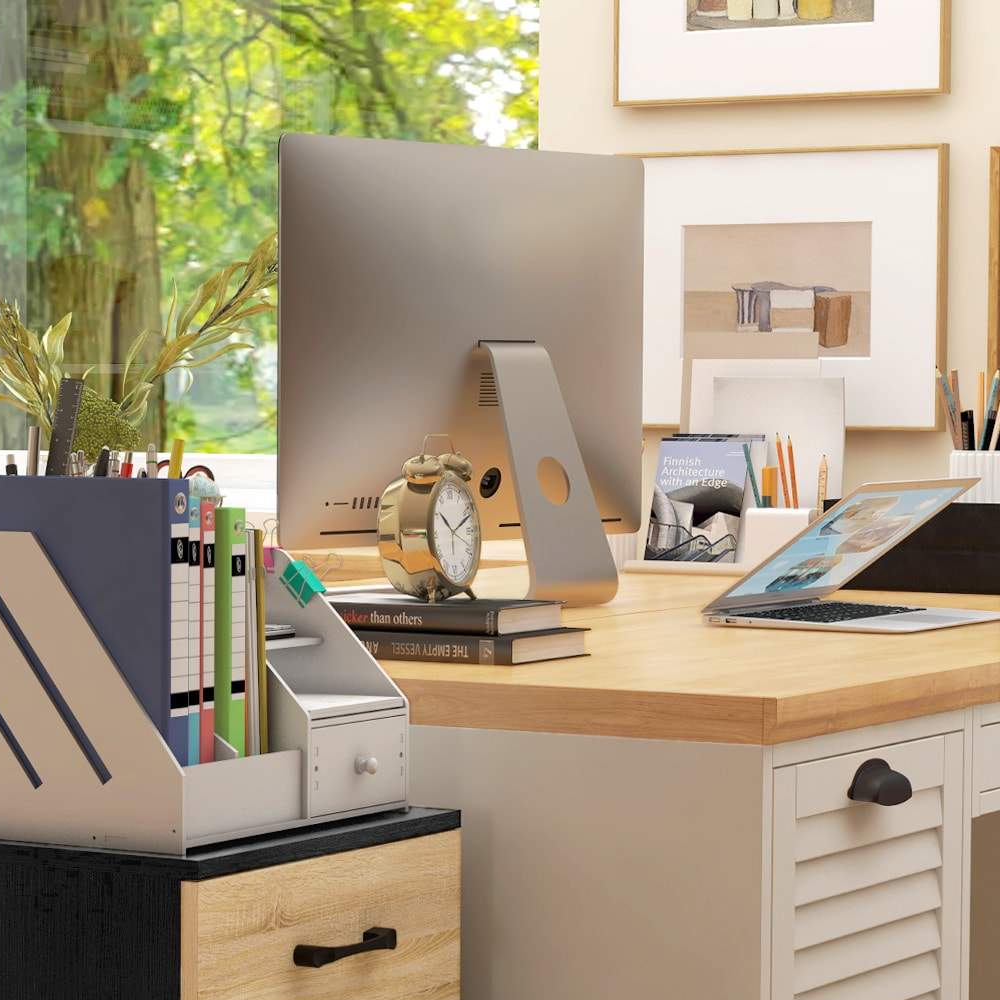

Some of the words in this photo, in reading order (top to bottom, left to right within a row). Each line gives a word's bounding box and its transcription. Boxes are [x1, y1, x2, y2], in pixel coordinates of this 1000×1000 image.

[663, 456, 701, 467] Finnish
[661, 467, 726, 477] Architecture
[660, 476, 682, 487] with
[685, 478, 699, 487] an
[701, 478, 728, 489] Edge
[370, 610, 391, 624] than
[393, 611, 423, 626] others
[391, 642, 420, 656] VESSEL
[422, 643, 450, 657] EMPTY
[452, 645, 469, 658] THE
